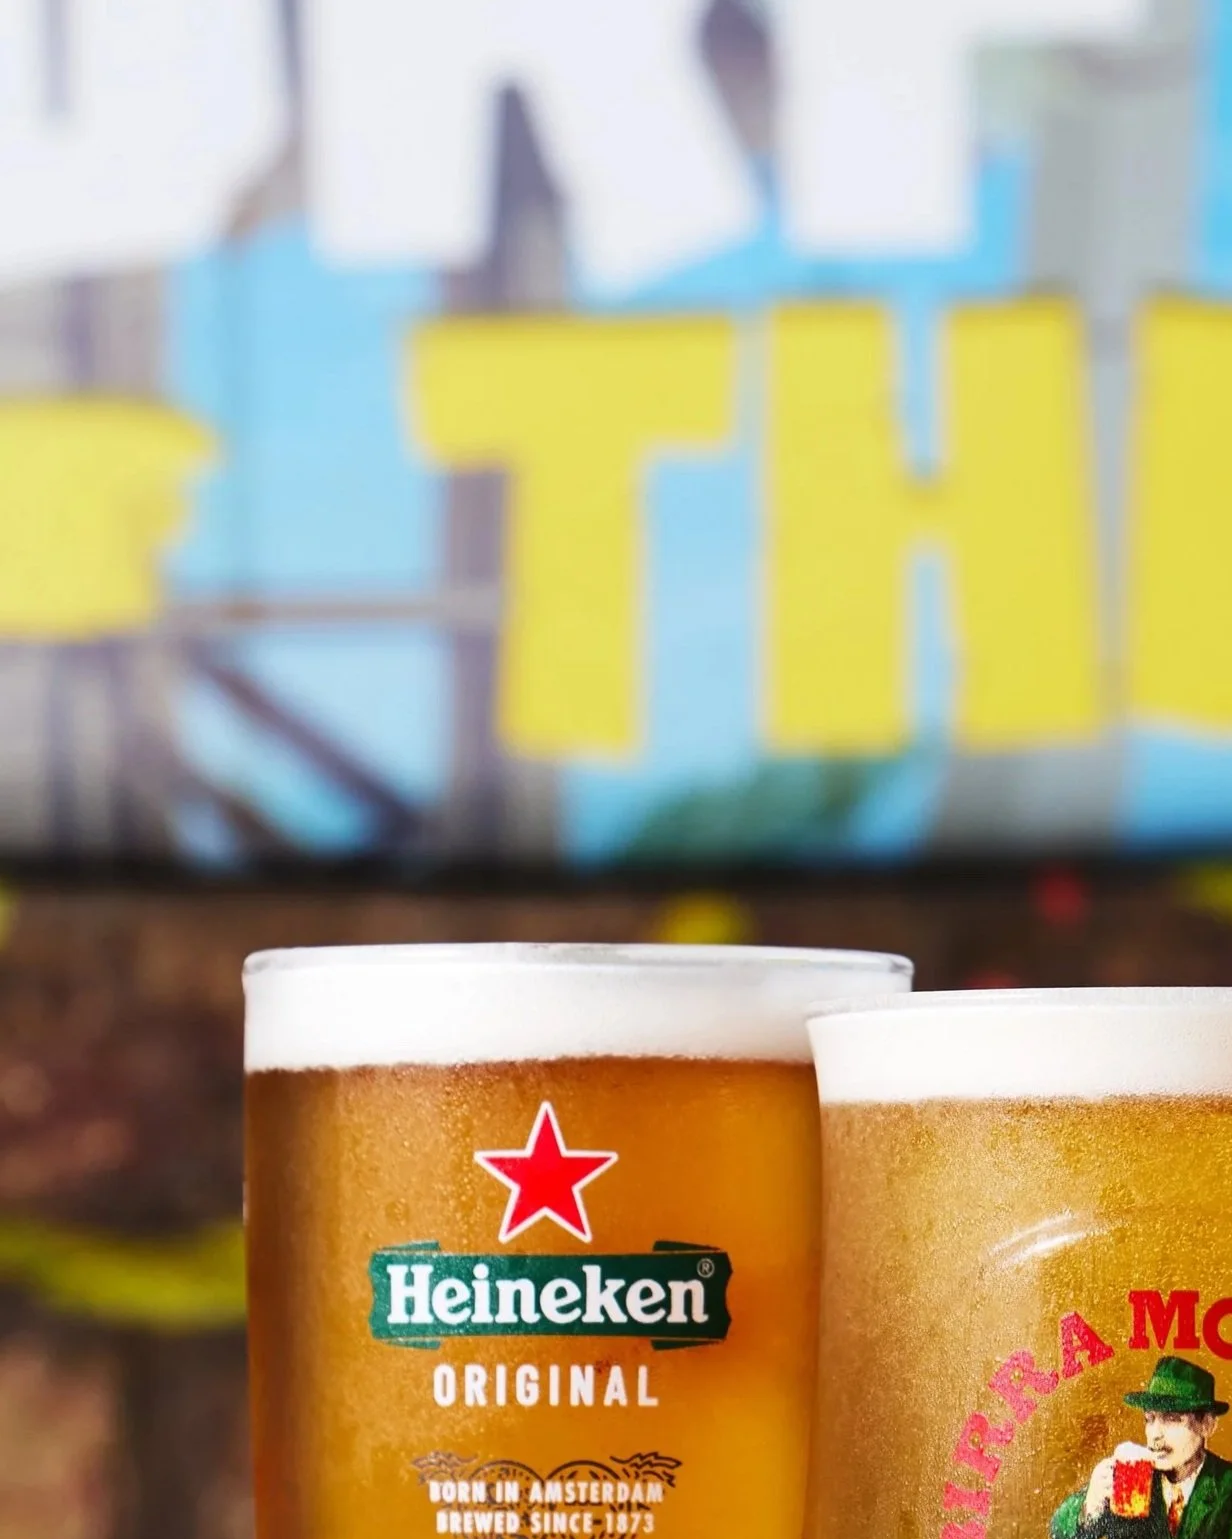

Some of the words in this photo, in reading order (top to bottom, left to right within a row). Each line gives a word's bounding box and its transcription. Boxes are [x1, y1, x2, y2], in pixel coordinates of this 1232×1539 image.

[433, 1363, 660, 1408] ORIGINAL
[429, 1480, 487, 1503] BORN
[496, 1480, 519, 1503] IN
[529, 1480, 664, 1504] AMSTERDAM
[436, 1510, 519, 1534] BREWED
[530, 1511, 593, 1534] SINCE
[605, 1512, 655, 1534] 1873
